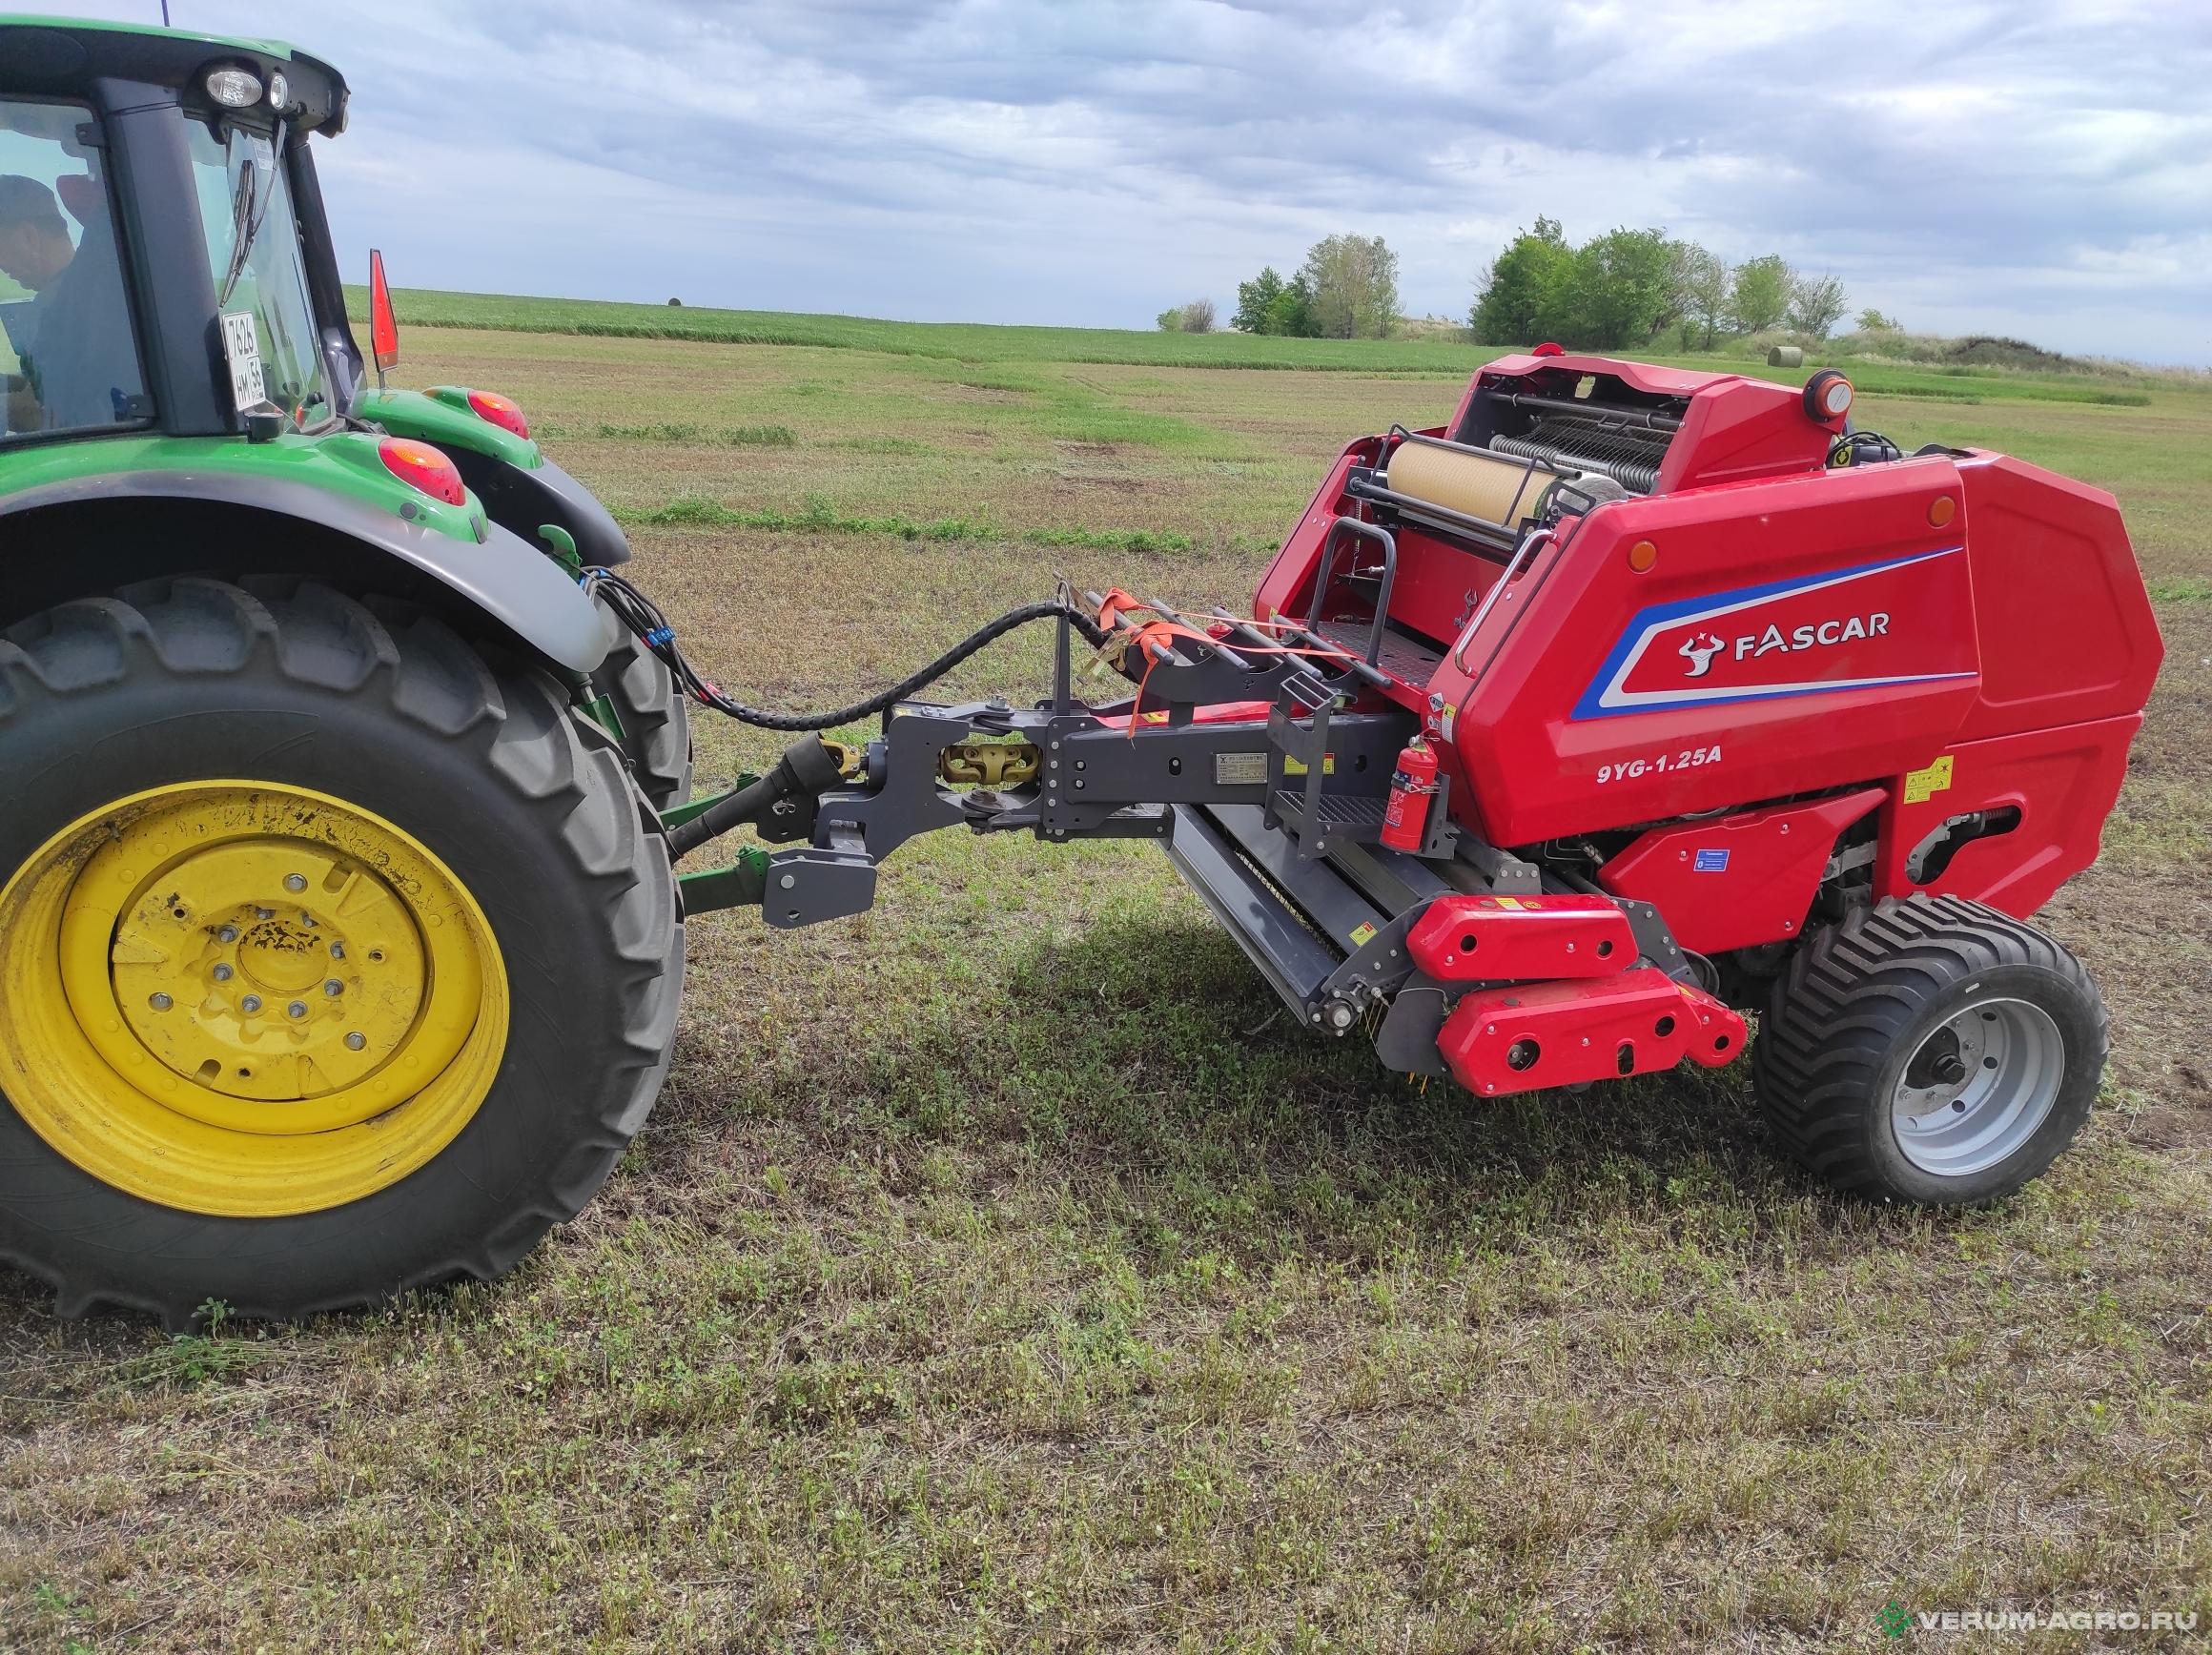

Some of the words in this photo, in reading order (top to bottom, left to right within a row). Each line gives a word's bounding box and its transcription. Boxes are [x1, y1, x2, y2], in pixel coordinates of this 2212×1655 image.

[229, 317, 254, 358] 7626
[249, 360, 261, 389] 56
[1734, 611, 1891, 661] FASCAR
[1596, 745, 1722, 784] 9YG-1.25A
